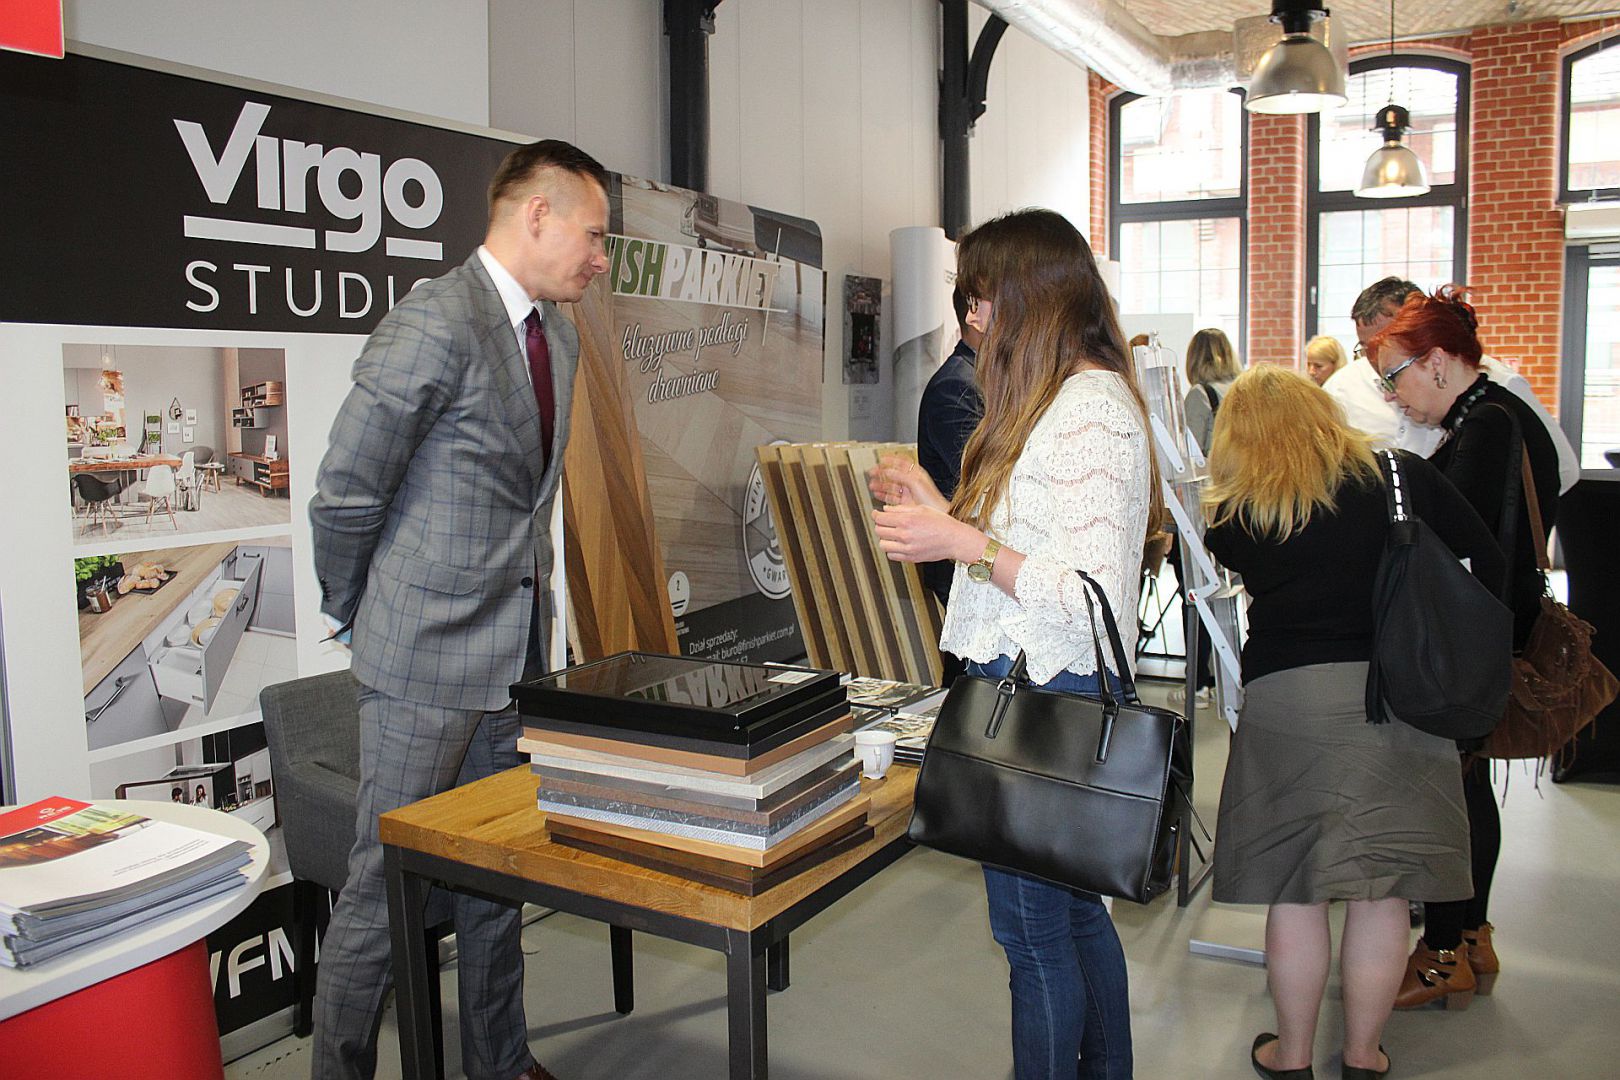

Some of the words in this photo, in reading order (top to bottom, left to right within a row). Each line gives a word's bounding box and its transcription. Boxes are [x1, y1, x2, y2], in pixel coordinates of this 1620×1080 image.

[173, 101, 443, 252] Virgo
[185, 260, 433, 318] STUDI
[605, 236, 778, 308] ISHPARKIET
[622, 324, 694, 373] kluzywne
[695, 312, 748, 360] podłogi
[648, 368, 719, 403] drewniane
[767, 569, 786, 582] GWAR
